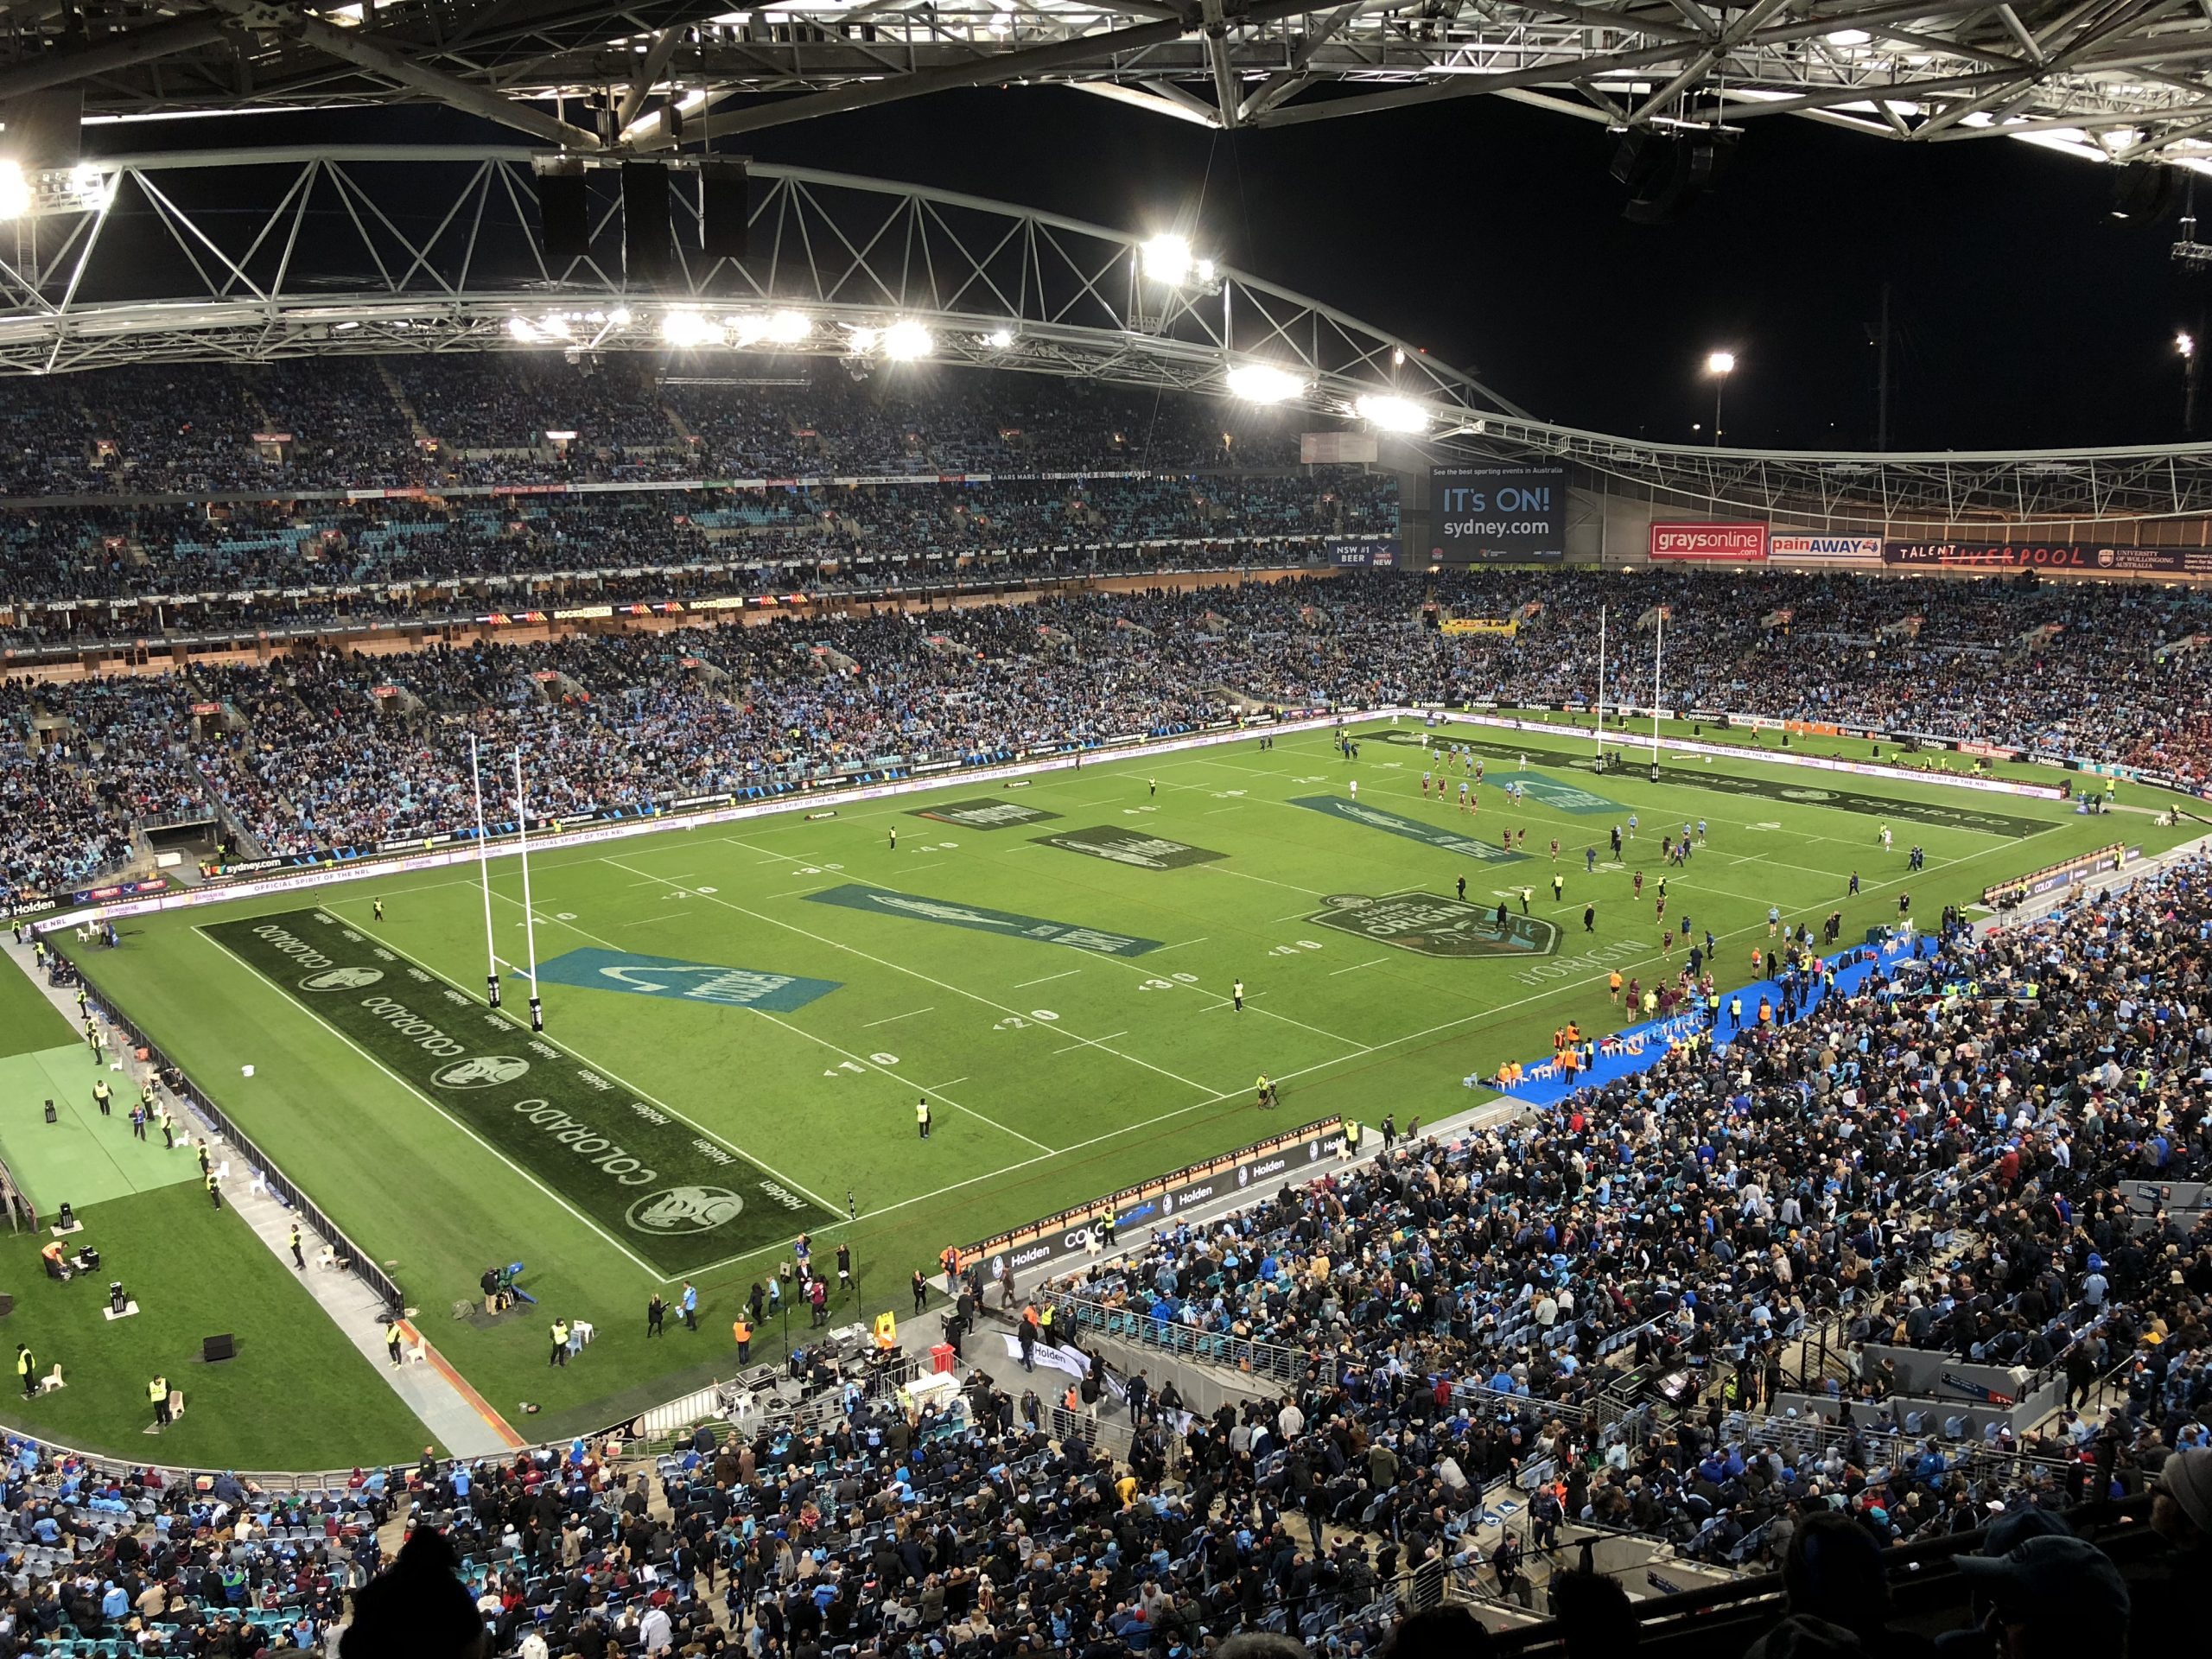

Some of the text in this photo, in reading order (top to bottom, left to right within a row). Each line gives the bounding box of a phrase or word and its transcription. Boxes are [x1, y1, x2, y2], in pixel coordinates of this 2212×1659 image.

[1473, 467, 1501, 476] sporting
[1444, 487, 1550, 512] IT's ON!
[1444, 518, 1549, 537] sydney.com
[1658, 531, 1758, 550] graysonline
[1772, 537, 1863, 553] painAWAY
[1361, 545, 1370, 554] #1
[1900, 545, 1956, 559] TALENT
[1941, 546, 2085, 567] LIVERPOOL
[744, 561, 763, 569] rebel
[783, 560, 801, 569] rebel
[892, 553, 908, 562] rebel
[532, 573, 553, 582] rebel
[576, 571, 598, 580] rebel
[663, 566, 683, 575] rebel
[437, 579, 460, 588] rebel
[170, 594, 197, 604] rebel
[228, 591, 253, 601] rebel
[283, 588, 308, 597] rebel
[110, 598, 137, 607] rebel
[1526, 702, 1550, 711] Holden
[1244, 713, 1271, 723] sydney.com
[1921, 739, 1948, 750] Holden
[2037, 756, 2064, 768] Holden
[1897, 771, 1925, 780] OFFICIAL
[1927, 774, 1947, 783] SPIRIT
[559, 813, 594, 823] sydney.com
[1847, 798, 2011, 827] COLORADO
[526, 840, 558, 849] OFFICIAL
[561, 836, 582, 844] SPIRIT
[2126, 849, 2139, 859] Holden
[226, 858, 282, 874] sydney.com
[2101, 860, 2114, 868] Holden
[254, 880, 293, 892] OFFICIAL
[296, 875, 321, 886] SPIRIT
[337, 871, 353, 880] THE
[354, 869, 370, 878] NRL
[2075, 869, 2088, 879] Holden
[140, 880, 164, 889] TOOHEYS
[13, 899, 56, 916] Holden
[1351, 902, 1413, 918] Holden
[1360, 903, 1433, 926] STATE OF
[50, 918, 67, 928] NRL
[1366, 905, 1477, 935] ORIGIN
[252, 925, 334, 969] COLORADO
[373, 947, 397, 962] Holden
[1508, 939, 1659, 987] #ORIGIN
[406, 968, 435, 983] Holden
[443, 989, 473, 1007] Holden
[360, 996, 465, 1058] COLORADO
[484, 1014, 517, 1032] Holden
[528, 1039, 563, 1060] Holden
[577, 1069, 615, 1092] Holden
[631, 1101, 672, 1127] Holden
[513, 1098, 658, 1186] COLORADO
[691, 1137, 737, 1166] Holden
[1253, 1159, 1286, 1179] Holden
[758, 1179, 809, 1211] Holden
[1179, 1186, 1213, 1206] Holden
[1011, 1244, 1051, 1268] Holden
[1034, 1344, 1066, 1363] Holden
